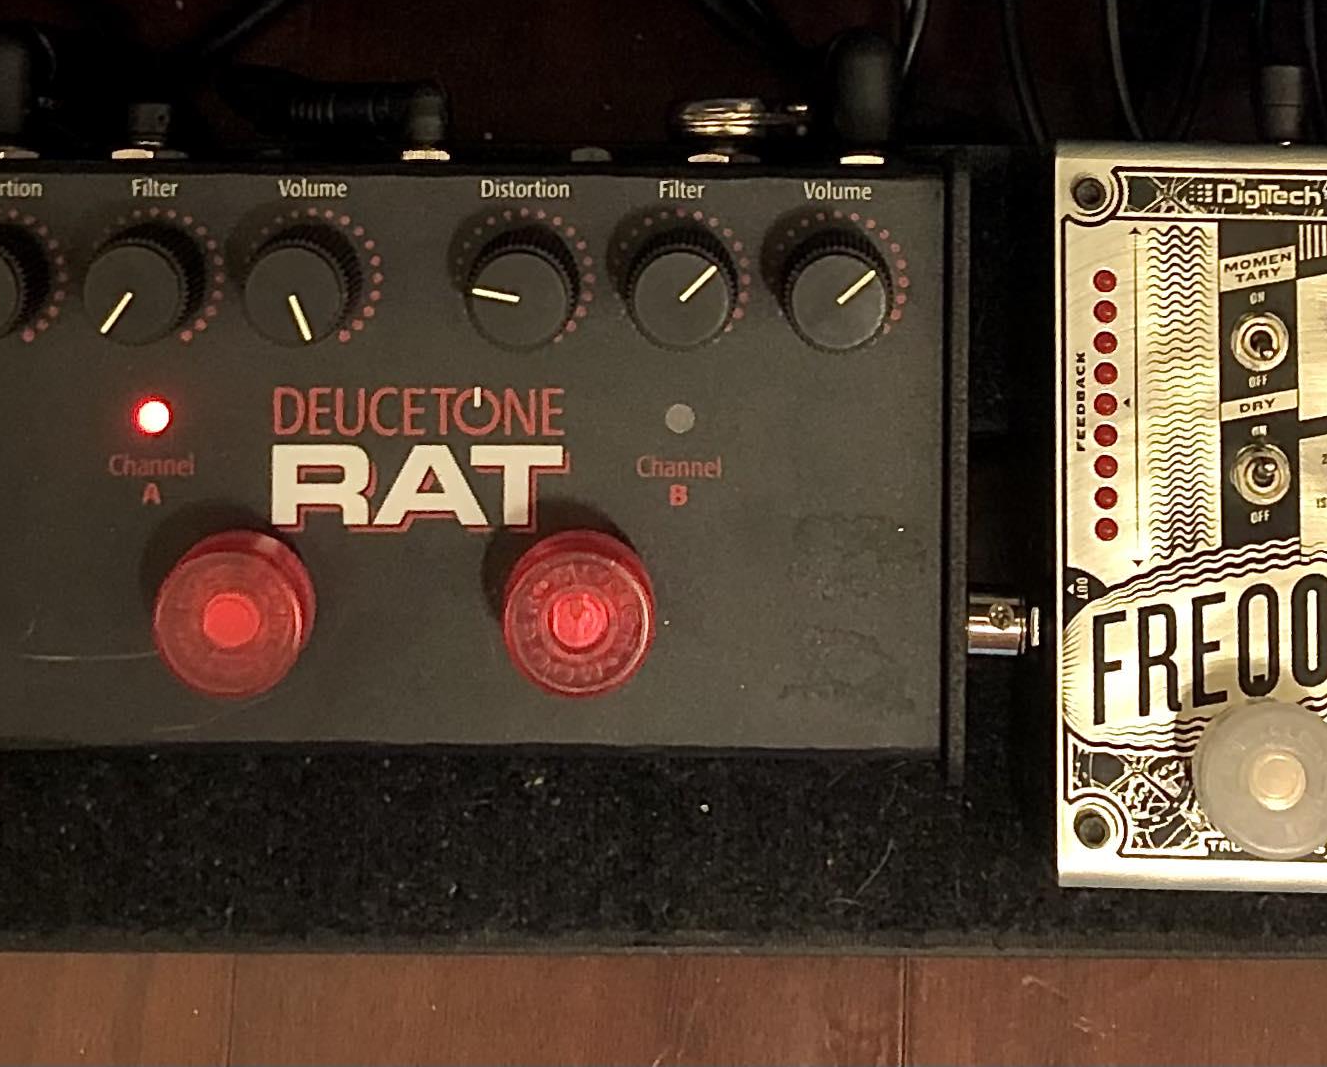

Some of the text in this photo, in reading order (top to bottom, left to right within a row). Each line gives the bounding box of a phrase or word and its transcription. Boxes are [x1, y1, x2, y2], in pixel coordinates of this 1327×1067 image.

[131, 180, 178, 197] Filter
[278, 180, 348, 197] Volume
[480, 179, 570, 199] Distortion
[658, 180, 705, 199] Filter
[804, 181, 872, 201] Volume
[1216, 184, 1323, 208] DigiTech
[1224, 252, 1292, 273] MOMEN
[1235, 267, 1282, 283] TARY
[273, 387, 565, 436] DEUCETONE
[1076, 352, 1086, 453] FEEDBACK
[1239, 399, 1276, 414] DRY
[109, 454, 194, 477] Channel
[636, 455, 723, 478] Channel
[142, 484, 162, 505] A
[270, 443, 568, 531] RAT
[670, 485, 688, 506] B
[1250, 510, 1270, 523] OFF
